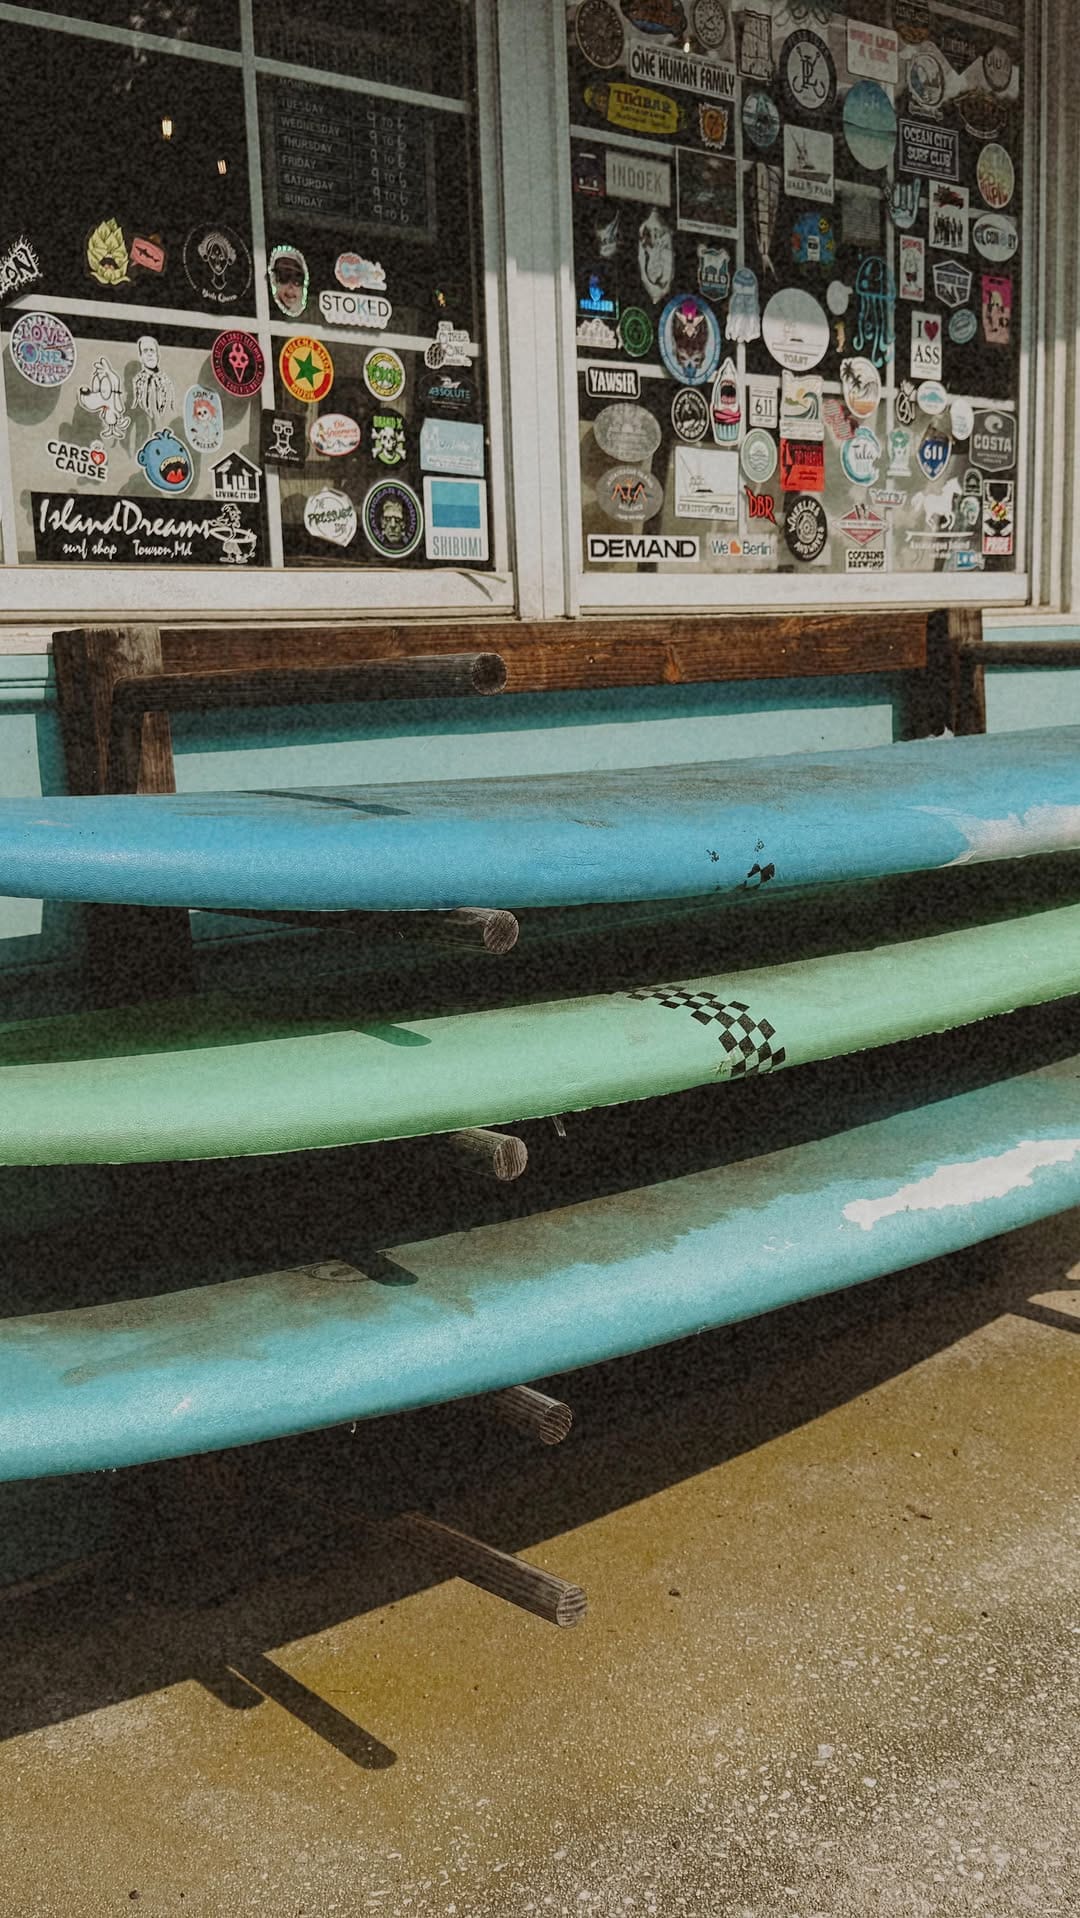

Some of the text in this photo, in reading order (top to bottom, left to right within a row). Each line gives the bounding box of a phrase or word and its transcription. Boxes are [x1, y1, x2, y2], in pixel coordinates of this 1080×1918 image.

[631, 50, 655, 76] ONE
[659, 57, 697, 87] HUMAN
[700, 66, 735, 95] FAMILY
[281, 99, 324, 114] TUESDAY
[281, 116, 341, 137] WEDNESDAY
[282, 135, 333, 154] THURSDAY
[903, 126, 954, 150] OCEAN CITY
[282, 154, 317, 170] FRIDAY
[906, 145, 930, 162] SURF
[930, 151, 953, 168] CLUB
[283, 173, 335, 192] SATURDAY
[611, 164, 663, 194] INDOEK
[284, 193, 323, 209] SUNDAY
[322, 294, 390, 318] STOKED
[21, 325, 67, 346] LOVE
[916, 320, 923, 339] I
[913, 344, 940, 365] ASS
[23, 363, 67, 375] ANOTHER
[588, 369, 638, 395] YAWSIR
[754, 398, 773, 416] 611
[47, 441, 90, 463] CARS
[923, 445, 943, 460] 611
[973, 433, 1013, 452] COSTA
[55, 459, 107, 480] CAUSE
[62, 539, 88, 559] surf
[91, 539, 118, 560] shop
[432, 536, 483, 557] SHIBUMI
[590, 539, 697, 558] DEMAND
[711, 540, 772, 556] We Berlin
[847, 550, 885, 560] COUSINS
